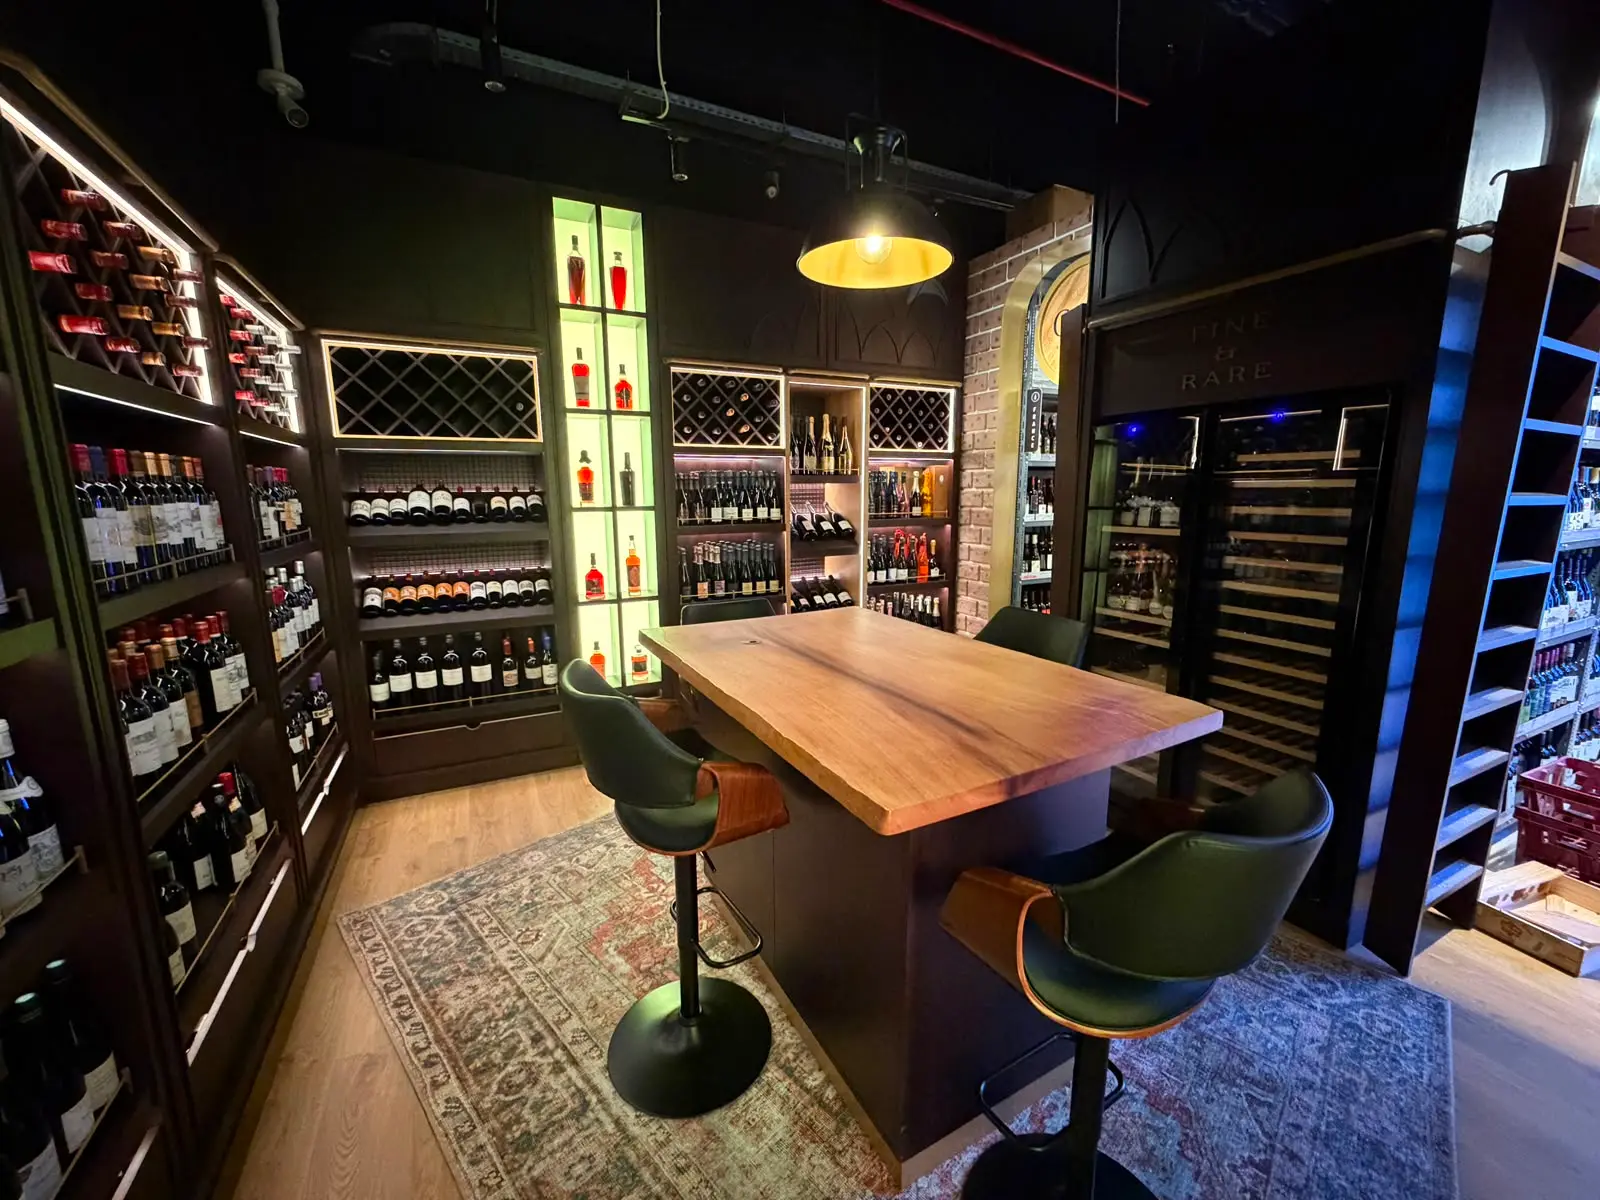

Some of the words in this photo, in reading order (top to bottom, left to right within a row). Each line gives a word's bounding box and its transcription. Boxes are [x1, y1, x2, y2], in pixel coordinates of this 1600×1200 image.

[1192, 310, 1272, 344] FINE
[1213, 345, 1237, 362] &
[1182, 361, 1272, 391] RARE
